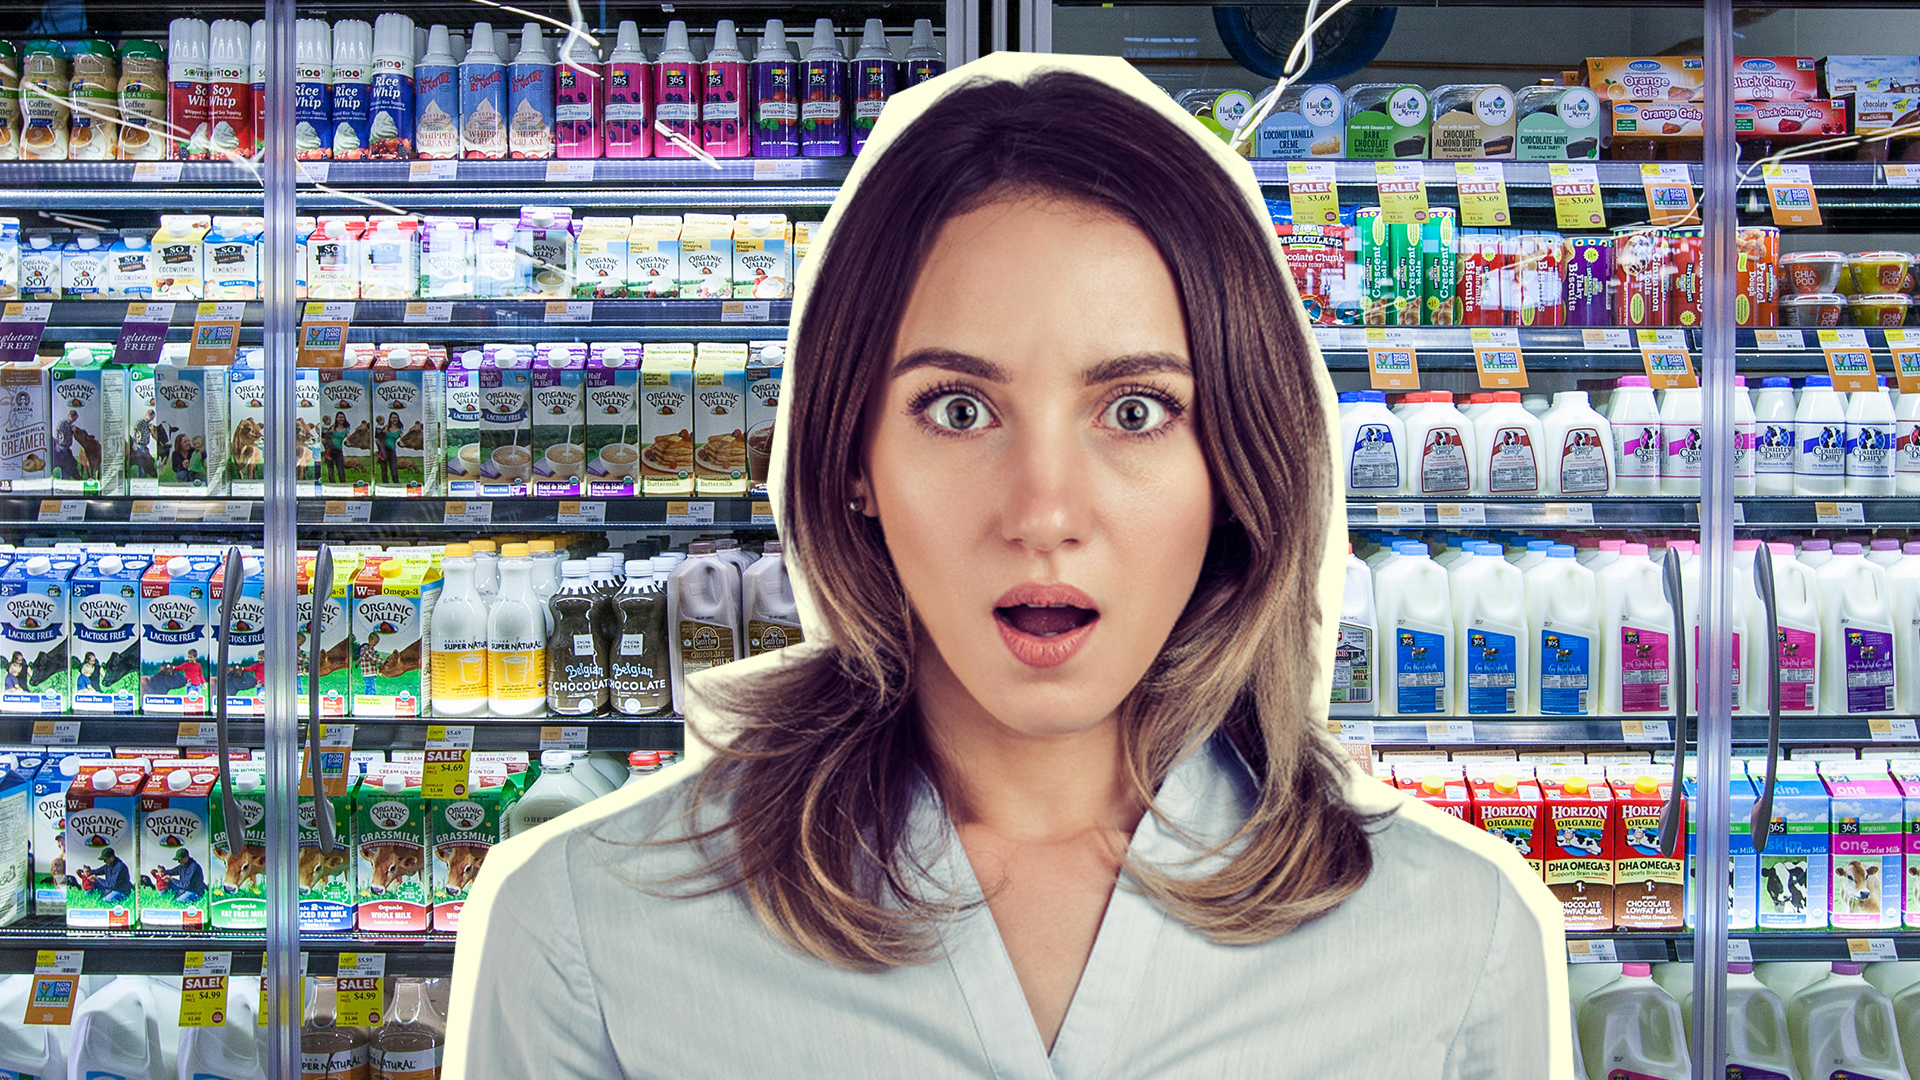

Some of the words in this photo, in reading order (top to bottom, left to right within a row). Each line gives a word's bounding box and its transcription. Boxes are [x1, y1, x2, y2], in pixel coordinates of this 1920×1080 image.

[375, 75, 399, 86] Rice
[613, 76, 627, 86] 365
[669, 76, 684, 85] 365
[1623, 76, 1669, 87] Orange
[1761, 77, 1795, 91] Cherry
[212, 85, 233, 96] Soy
[336, 85, 358, 96] Rice
[373, 86, 401, 99] Whip
[1633, 86, 1659, 98] Gels
[1752, 88, 1773, 99] Gels
[334, 96, 360, 109] Whip
[1307, 102, 1320, 110] Hail
[1862, 100, 1889, 108] chocolate
[1641, 109, 1677, 121] Orange
[1678, 109, 1702, 120] Gels
[1758, 109, 1778, 119] Black
[1779, 108, 1806, 119] Cherry
[419, 132, 455, 140] WHIPPED
[469, 131, 505, 139] WHIPPED
[1264, 130, 1290, 139] COCONUT
[1291, 130, 1314, 139] VANILLA
[1364, 131, 1380, 139] DARK
[1443, 131, 1475, 139] CHOCOLATE
[1354, 140, 1389, 149] CHOCOLATE
[1436, 139, 1461, 148] ALMOND
[1463, 139, 1482, 148] BUTTER
[1521, 136, 1552, 144] CHOCOLATE
[1554, 136, 1568, 145] MINT
[1292, 184, 1329, 192] SALE!
[1381, 184, 1419, 192] SALE!
[1461, 183, 1498, 194] SALE!
[1556, 185, 1592, 195] SALE!
[324, 245, 340, 253] SO
[1315, 254, 1344, 262] Chunk
[1372, 246, 1381, 298] Crescent
[1407, 247, 1416, 298] Crescent
[1440, 247, 1449, 298] Crescent
[1795, 270, 1816, 279] CHIA
[26, 276, 47, 287] SOY
[73, 277, 95, 287] SOY
[1568, 262, 1578, 311] Biscuits
[1756, 263, 1766, 303] Pretzel
[1796, 278, 1815, 286] POD
[1, 333, 34, 343] gluten
[125, 333, 158, 343] gluten
[124, 343, 155, 351] FREE
[57, 384, 96, 397] ORGANIC
[159, 385, 199, 398] ORGANIC
[323, 385, 364, 398] ORGANIC
[377, 385, 417, 398] ORGANIC
[328, 393, 359, 402] VALLEY
[381, 393, 413, 402] VALLEY
[537, 392, 577, 405] ORGANIC
[591, 392, 631, 405] ORGANIC
[646, 392, 686, 405] ORGANIC
[700, 392, 740, 405] ORGANIC
[597, 399, 627, 408] VALLEY
[651, 399, 682, 408] VALLEY
[704, 399, 735, 409] VALLEY
[1, 426, 45, 441] ALMONDMILK
[1, 433, 45, 456] CREAMER
[1759, 446, 1792, 454] Country
[1765, 450, 1788, 460] Dairy
[1852, 448, 1889, 456] Country
[1858, 454, 1882, 463] Dairy
[356, 586, 368, 596] W
[383, 588, 419, 596] Omega-3
[7, 600, 55, 613] ORGANIC
[80, 600, 128, 614] ORGANIC
[149, 600, 197, 615] ORGANIC
[359, 603, 413, 617] ORGANIC
[12, 608, 49, 621] VALLEY
[85, 609, 122, 621] VALLEY
[154, 610, 192, 622] VALLEY
[364, 612, 406, 624] VALLEY
[8, 630, 36, 640] LACTOSE
[37, 630, 53, 639] FREE
[81, 631, 108, 640] LACTOSE
[110, 631, 127, 639] FREE
[150, 632, 178, 641] LACTOSE
[179, 632, 196, 640] FREE
[565, 663, 604, 680] Belgian
[612, 663, 653, 680] Belgian
[426, 751, 462, 761] SALE!
[441, 764, 463, 772] $4.69
[1837, 786, 1866, 794] one
[372, 806, 408, 816] ORGANIC
[447, 806, 483, 816] ORGANIC
[1481, 805, 1537, 819] HORIZON
[1552, 805, 1608, 819] HORIZON
[70, 816, 125, 829] ORGANIC
[146, 816, 200, 829] ORGANIC
[1487, 818, 1532, 828] ORGANIC
[1558, 818, 1602, 828] ORGANIC
[1842, 823, 1857, 832] 365
[77, 824, 117, 837] VALLEY
[152, 824, 193, 837] VALLEY
[361, 831, 420, 842] GRASSMILK
[436, 831, 495, 842] GRASSMILK
[1840, 839, 1868, 849] one
[1548, 862, 1568, 872] DHA
[1568, 861, 1610, 872] OMEGA-3
[1618, 861, 1638, 871] DHA
[1638, 861, 1680, 872] OMEGA-3
[1626, 900, 1670, 908] CHOCOLATE
[185, 978, 220, 989] SALE!
[340, 979, 374, 989] SALE!
[199, 991, 221, 1000] $4.99
